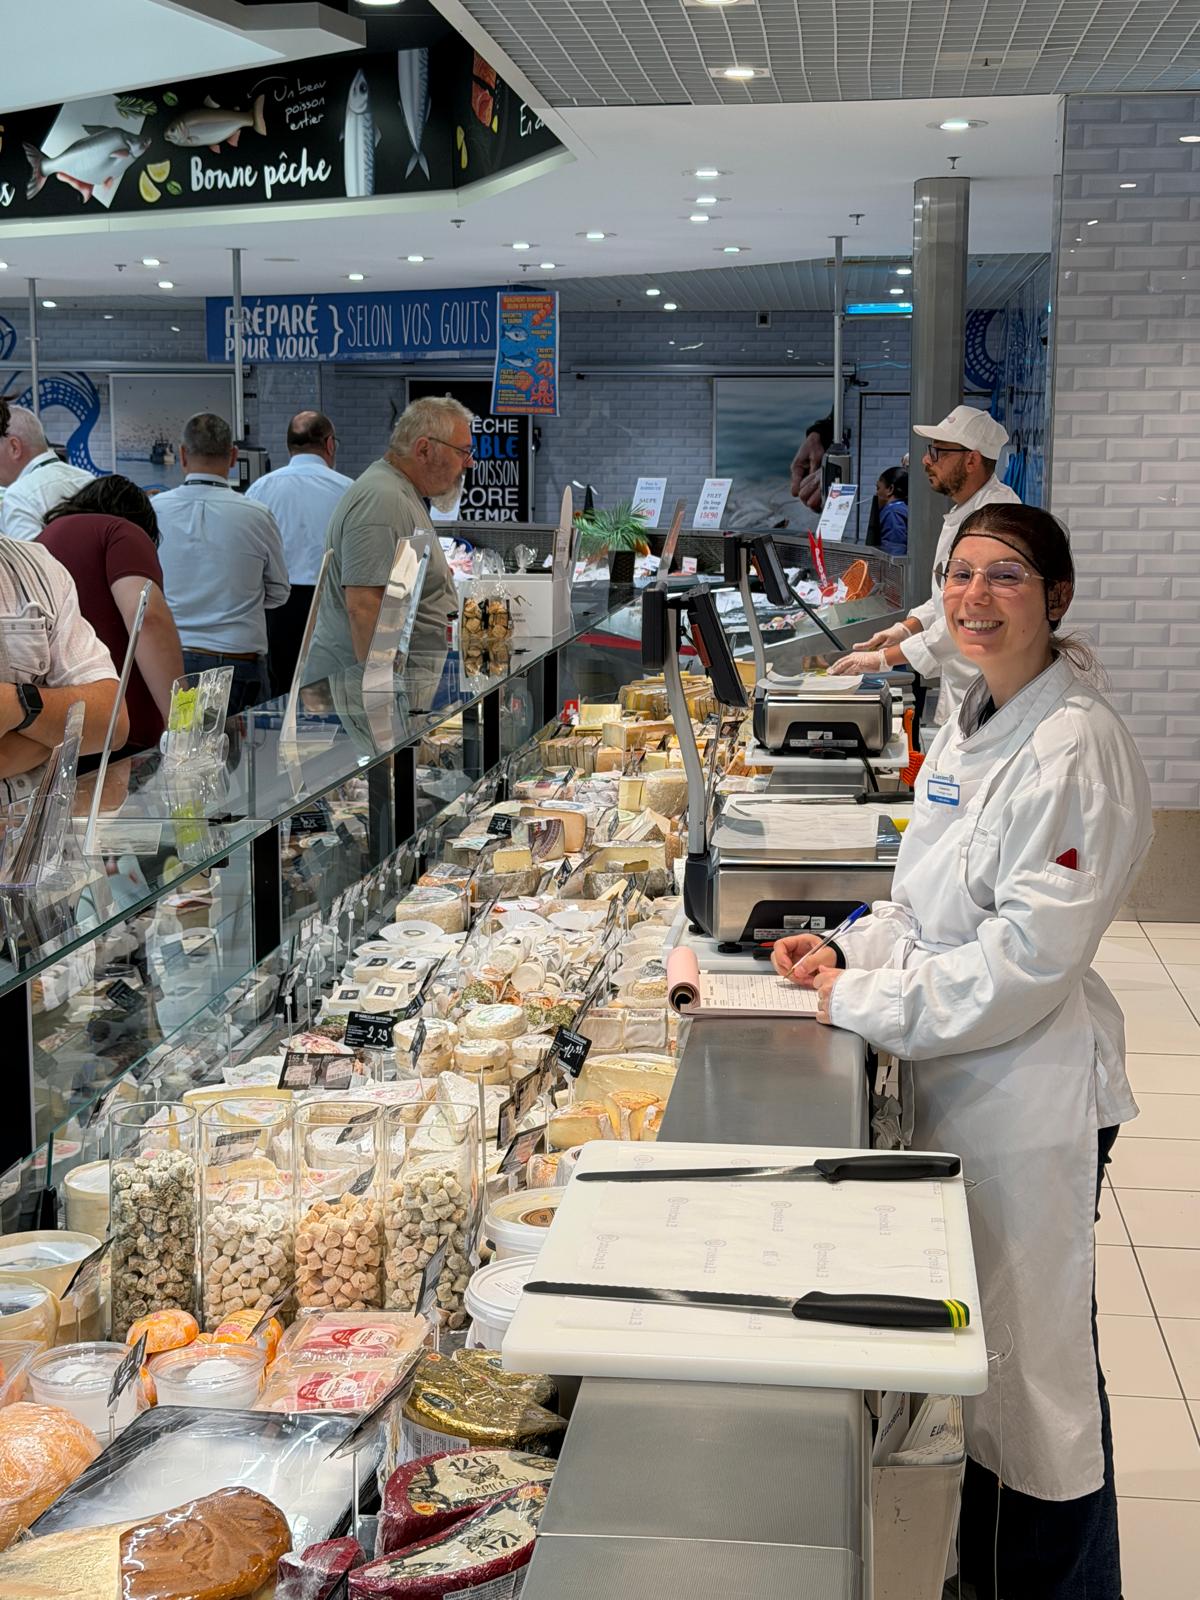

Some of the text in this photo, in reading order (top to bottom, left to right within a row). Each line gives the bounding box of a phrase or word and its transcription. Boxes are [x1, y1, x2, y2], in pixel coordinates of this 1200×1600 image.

[285, 97, 325, 124] poisson
[290, 111, 324, 130] entier
[191, 147, 332, 200] Bonne pêche
[347, 304, 392, 348] SELON
[401, 303, 432, 345] VOS
[441, 301, 490, 344] GOUTS
[276, 335, 319, 361] VOUS
[471, 415, 519, 434] ÊCHE
[472, 460, 519, 486] POISSON
[460, 487, 519, 507] CORE
[465, 1475, 530, 1496] PAPILLON
